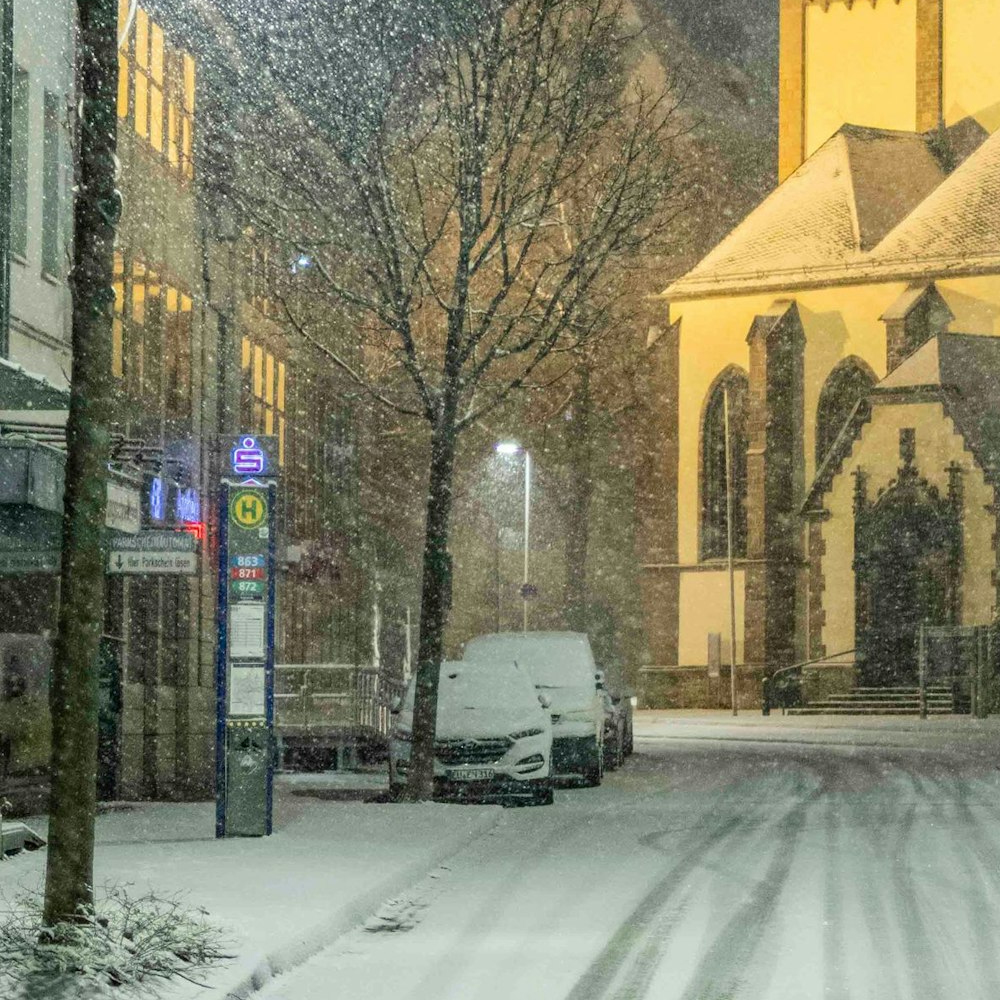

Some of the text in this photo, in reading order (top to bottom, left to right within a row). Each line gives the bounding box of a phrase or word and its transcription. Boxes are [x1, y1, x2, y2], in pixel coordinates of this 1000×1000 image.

[241, 500, 257, 519] H
[142, 556, 173, 568] Parkschein
[238, 556, 258, 567] 863
[239, 569, 256, 578] 871
[239, 581, 257, 591] 872
